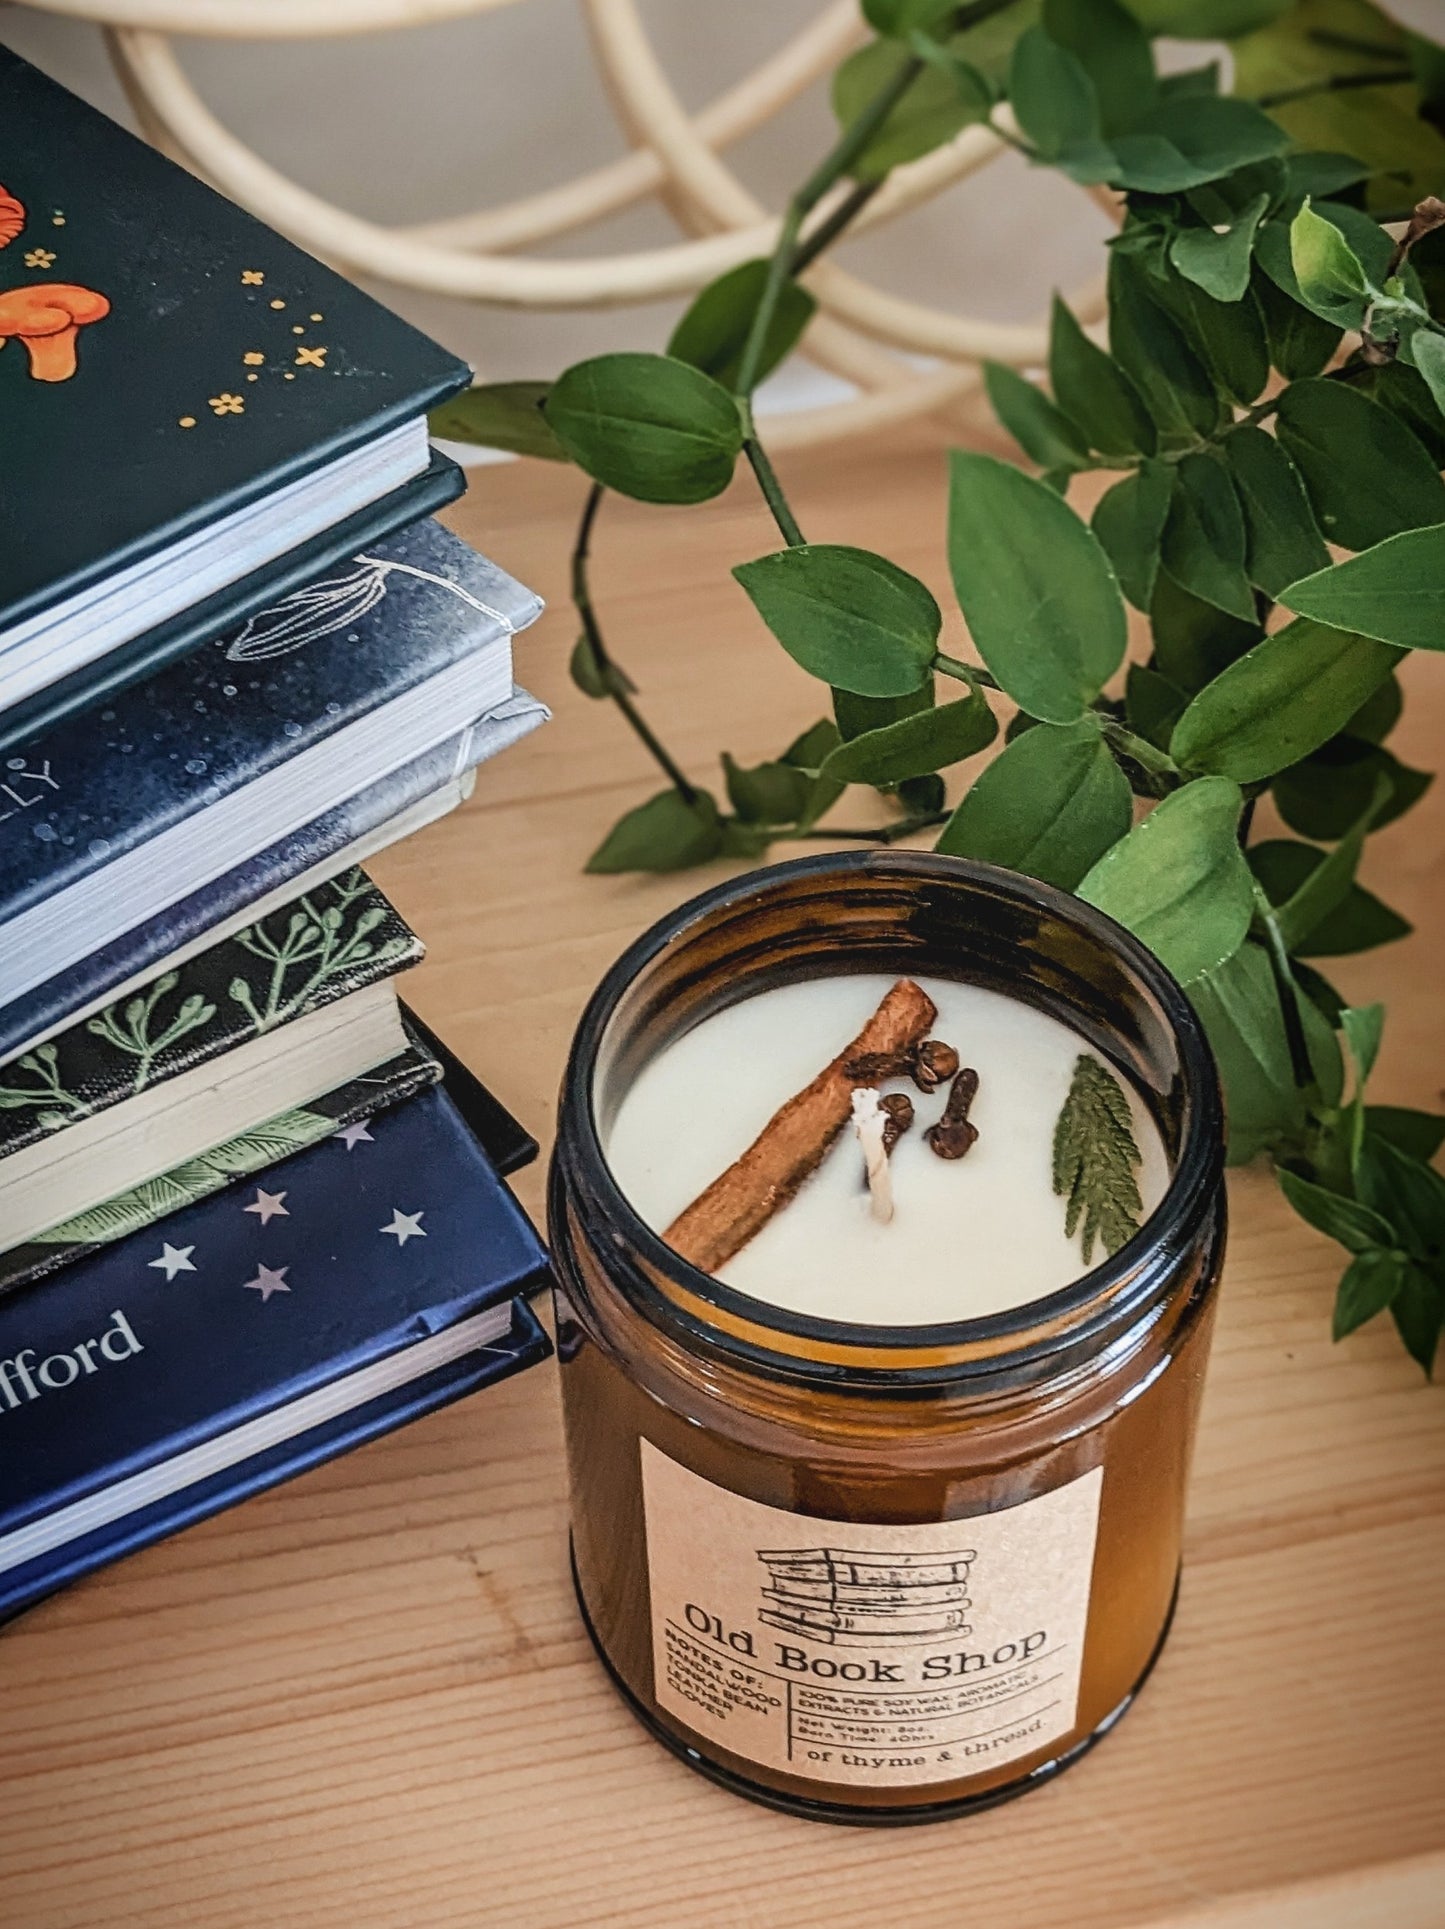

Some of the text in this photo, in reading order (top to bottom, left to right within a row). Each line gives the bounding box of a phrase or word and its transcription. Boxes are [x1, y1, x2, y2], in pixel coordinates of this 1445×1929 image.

[0, 1309, 145, 1414] fford
[665, 1628, 723, 1671] NOTES
[685, 1602, 1046, 1682] Old Book Shop
[666, 1642, 782, 1707] SANDALWOOD
[667, 1665, 733, 1712] LEATHER
[667, 1677, 726, 1719] CLOVES
[722, 1689, 768, 1715] BEAN
[798, 1699, 870, 1716] EXTRACTS
[807, 1751, 833, 1762] of
[841, 1755, 926, 1768] thyme
[936, 1751, 953, 1762] &
